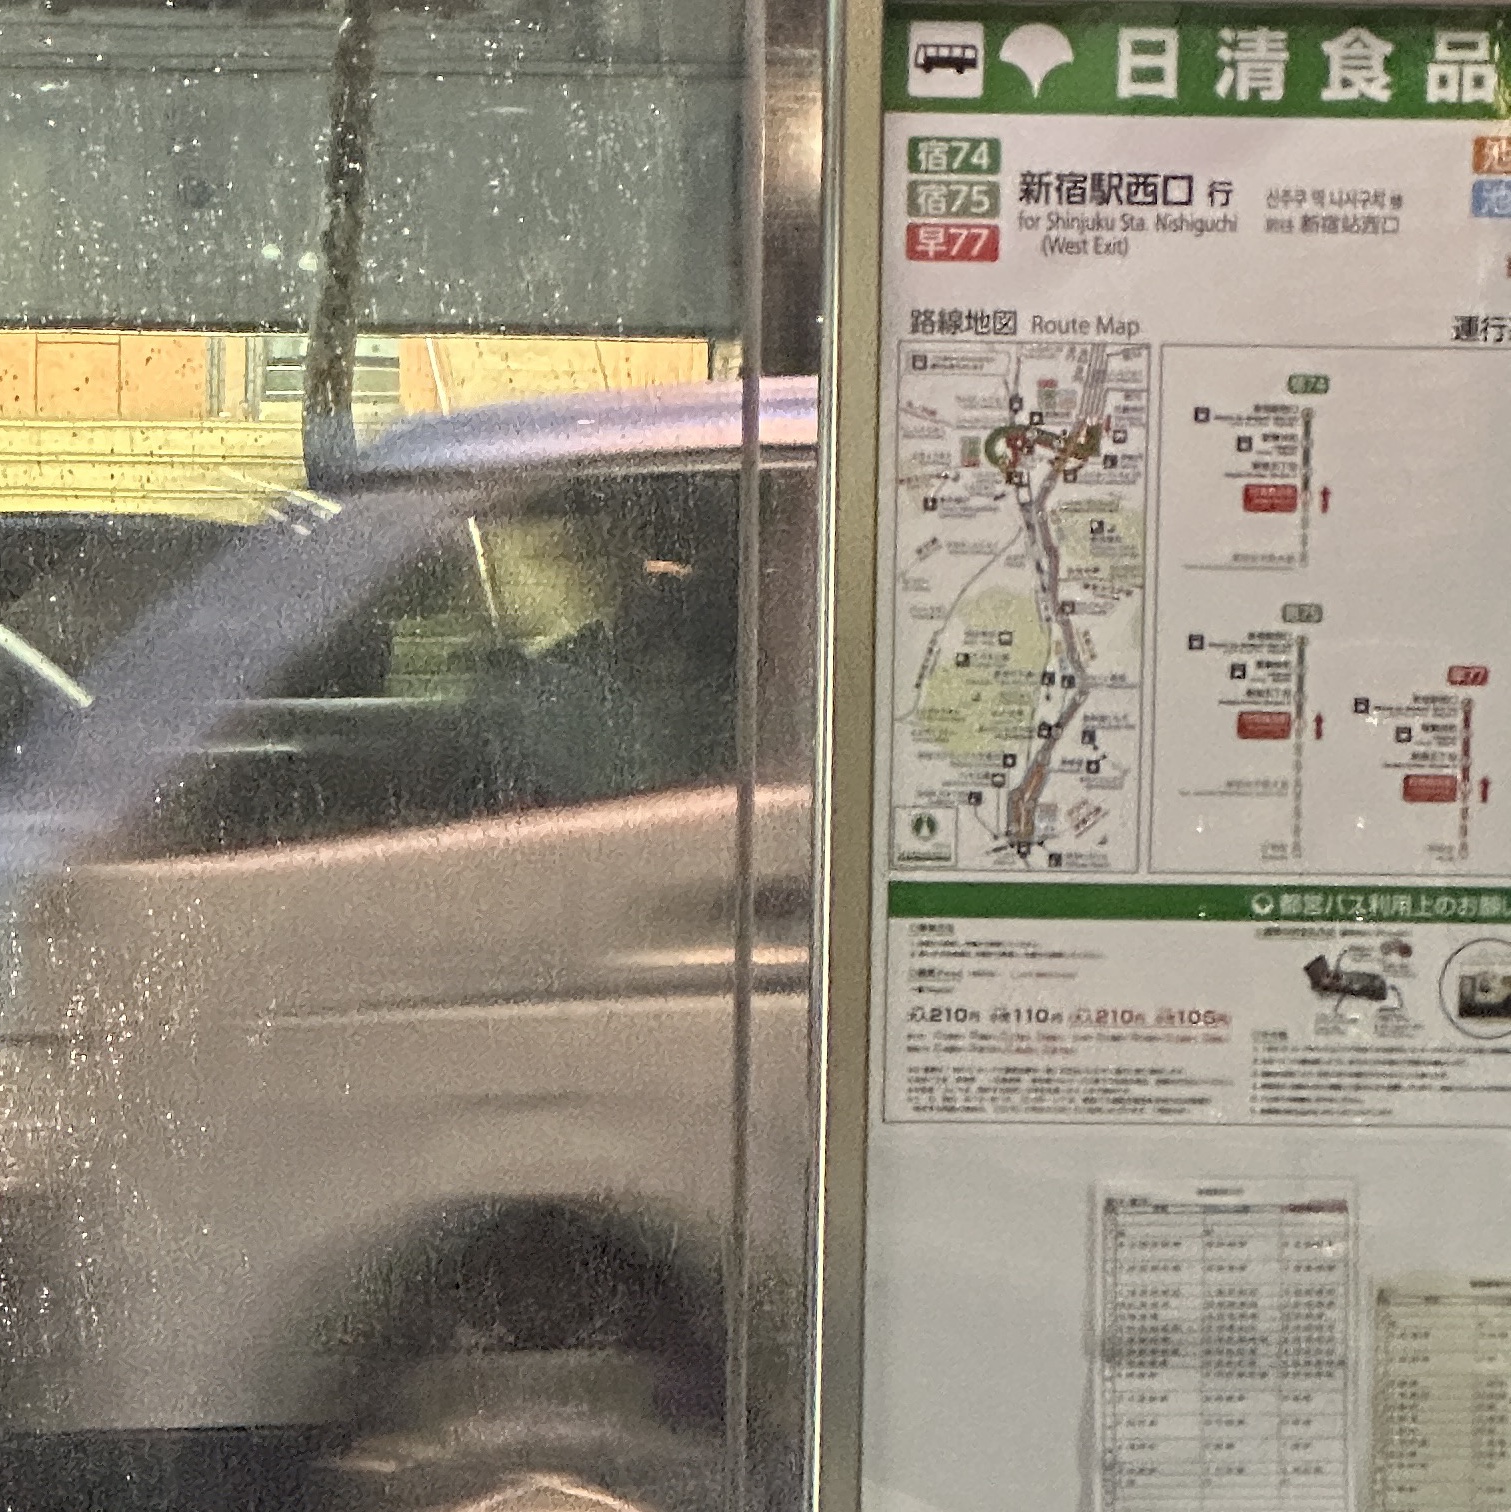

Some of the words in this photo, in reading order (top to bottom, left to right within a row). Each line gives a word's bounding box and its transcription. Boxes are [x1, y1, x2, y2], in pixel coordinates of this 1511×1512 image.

[1117, 27, 1498, 103] 日清食品
[917, 140, 990, 173] 宿74
[917, 183, 991, 215] 宿75
[1018, 170, 1193, 207] 新宿駅西口
[1207, 178, 1235, 208] 行
[1018, 211, 1041, 231] for
[1046, 211, 1116, 236] Shinjuku
[1155, 212, 1238, 237] Nishiguchi
[915, 226, 990, 259] 早77
[1042, 235, 1089, 257] (West
[1092, 235, 1130, 257] Exit)
[909, 308, 1018, 336] 路線地図
[1032, 315, 1090, 336] Route
[1096, 315, 1140, 341] Map
[1451, 315, 1511, 342] 運行
